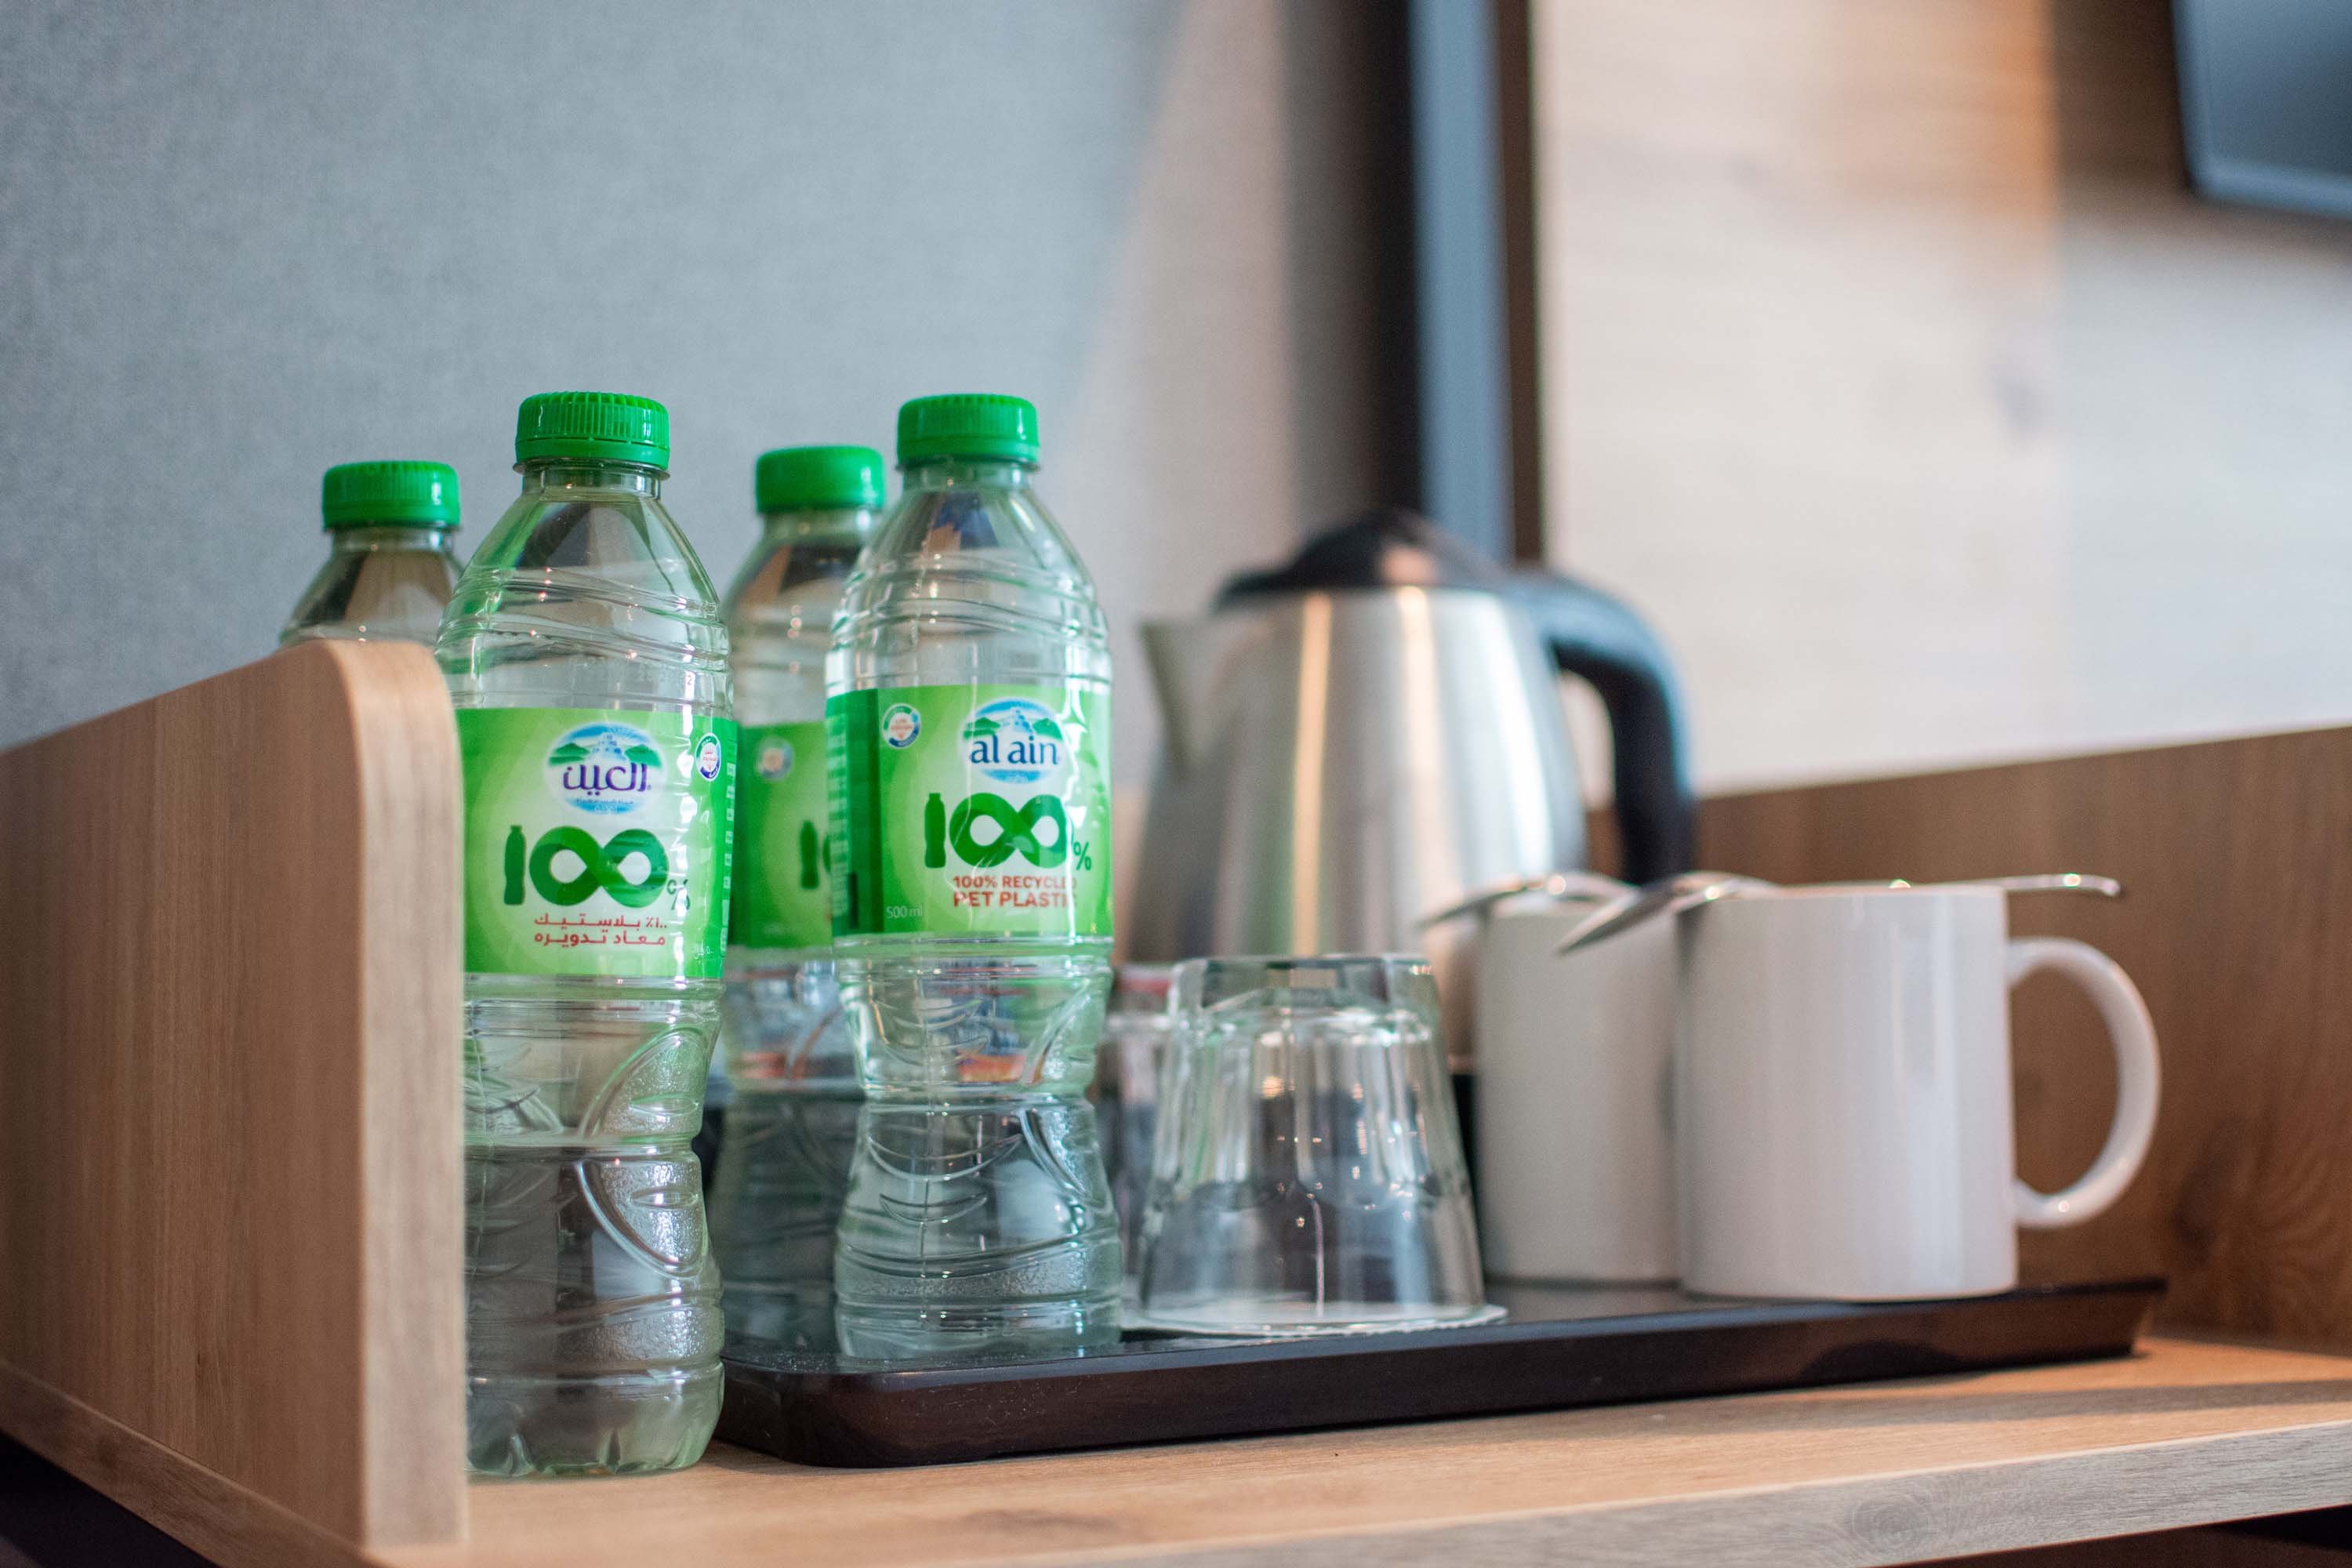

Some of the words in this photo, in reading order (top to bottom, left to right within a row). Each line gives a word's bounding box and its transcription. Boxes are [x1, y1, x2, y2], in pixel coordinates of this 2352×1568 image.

[970, 733, 1000, 764] al
[1007, 735, 1058, 766] ain
[563, 762, 648, 796] العين
[953, 875, 997, 888] 100%
[953, 891, 994, 907] PET
[886, 906, 908, 919] 500
[534, 913, 641, 931] بلاستيك
[534, 929, 609, 947] تدويره
[613, 931, 666, 946] معاد
